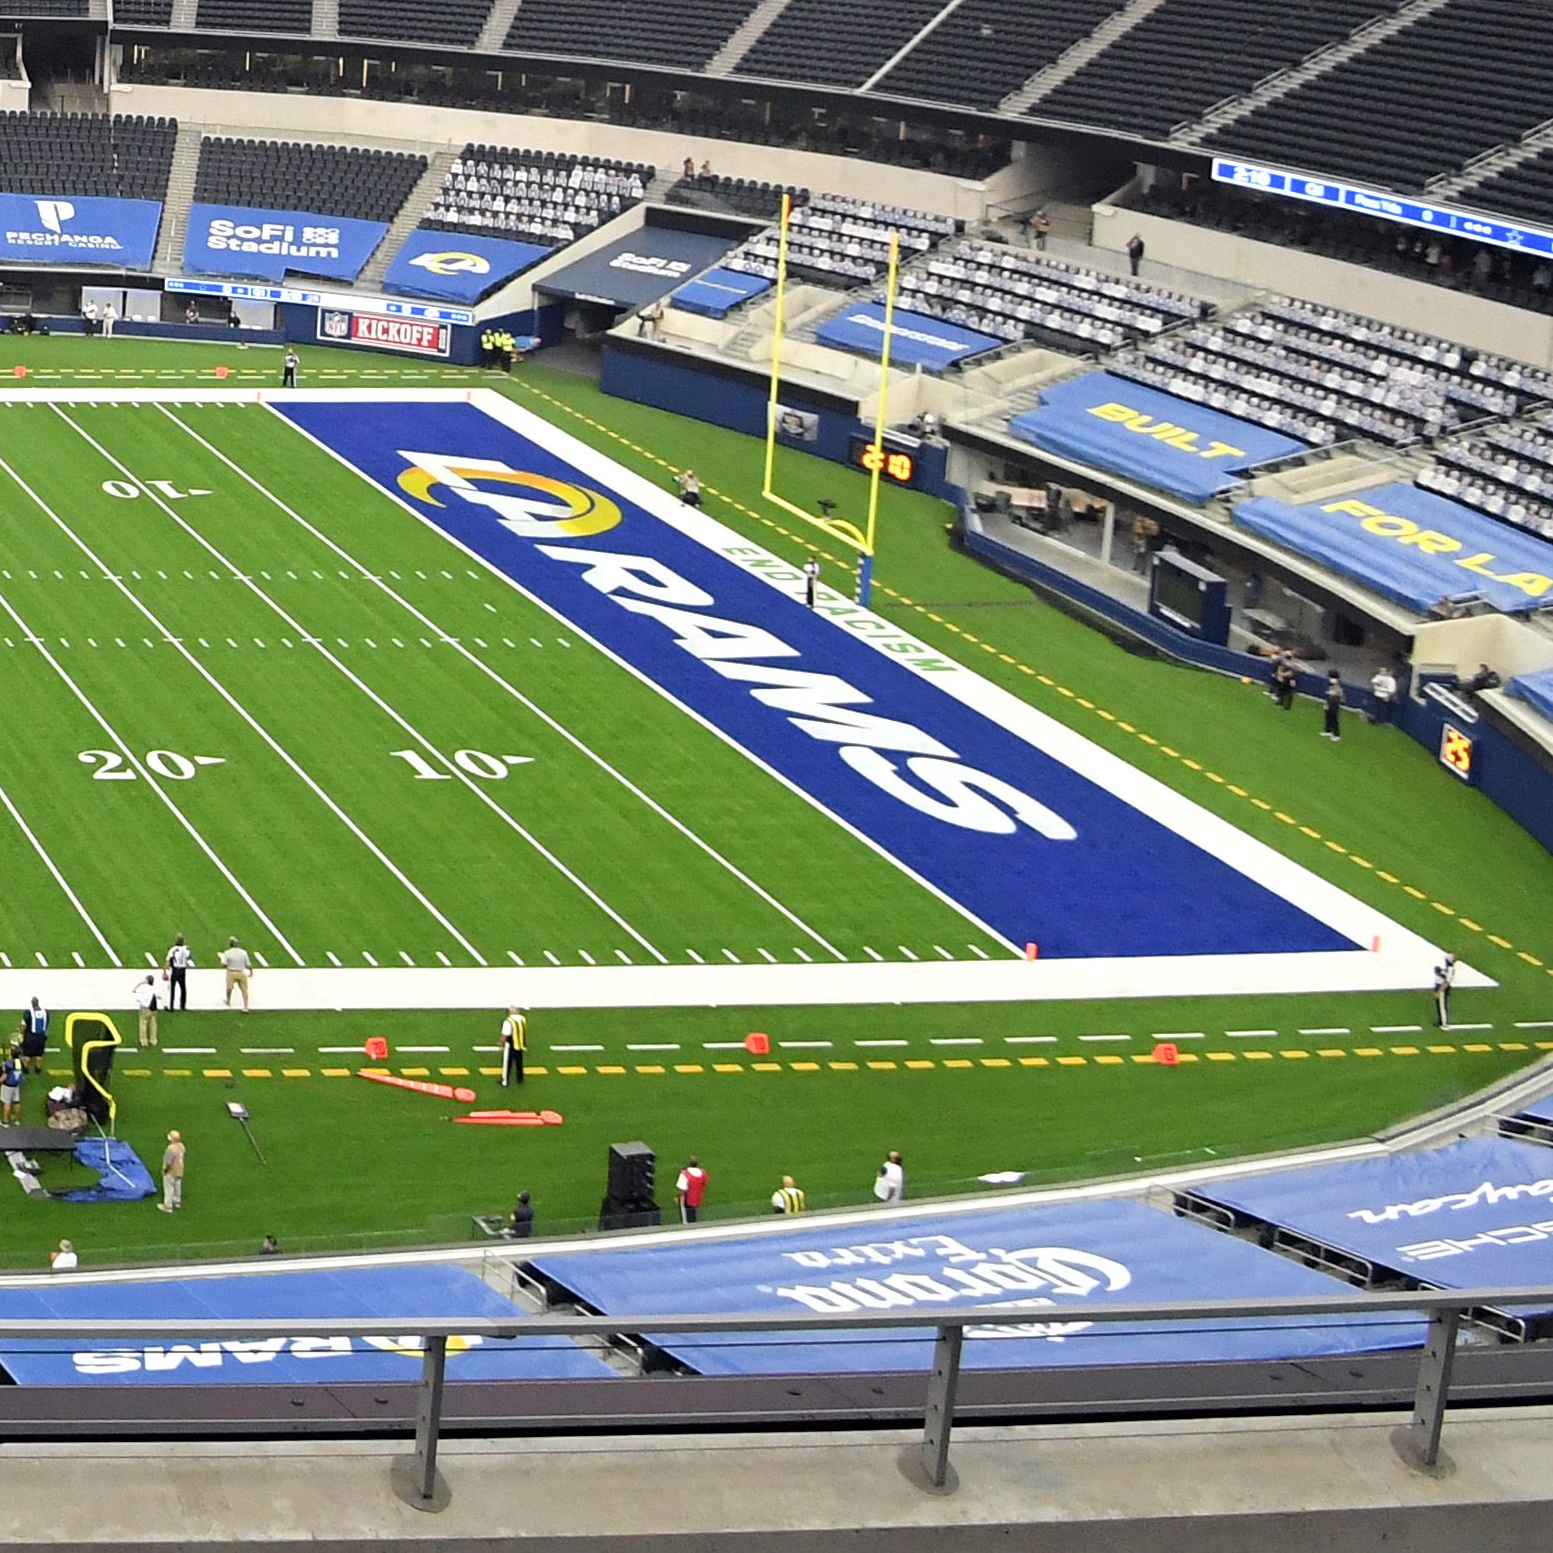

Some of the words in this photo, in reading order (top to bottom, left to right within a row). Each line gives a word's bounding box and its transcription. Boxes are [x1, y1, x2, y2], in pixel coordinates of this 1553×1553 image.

[1354, 193, 1377, 210] Pass
[1377, 198, 1403, 215] Yds
[1421, 208, 1434, 223] 0
[5, 231, 119, 245] PECHANGA
[209, 219, 295, 240] SoFi
[206, 236, 340, 259] Stadium
[356, 316, 435, 348] KICKOFF
[1085, 402, 1247, 462] BUILT
[99, 479, 191, 500] 10
[721, 544, 799, 583] END
[1320, 498, 1463, 555] FOR
[1453, 552, 1553, 598] LA
[534, 544, 1079, 842] RAMS
[76, 749, 196, 781] 20
[389, 747, 508, 781] 10
[788, 1232, 961, 1272] Extra
[777, 1246, 1134, 1315] Corona
[72, 1333, 354, 1376] RAMS
